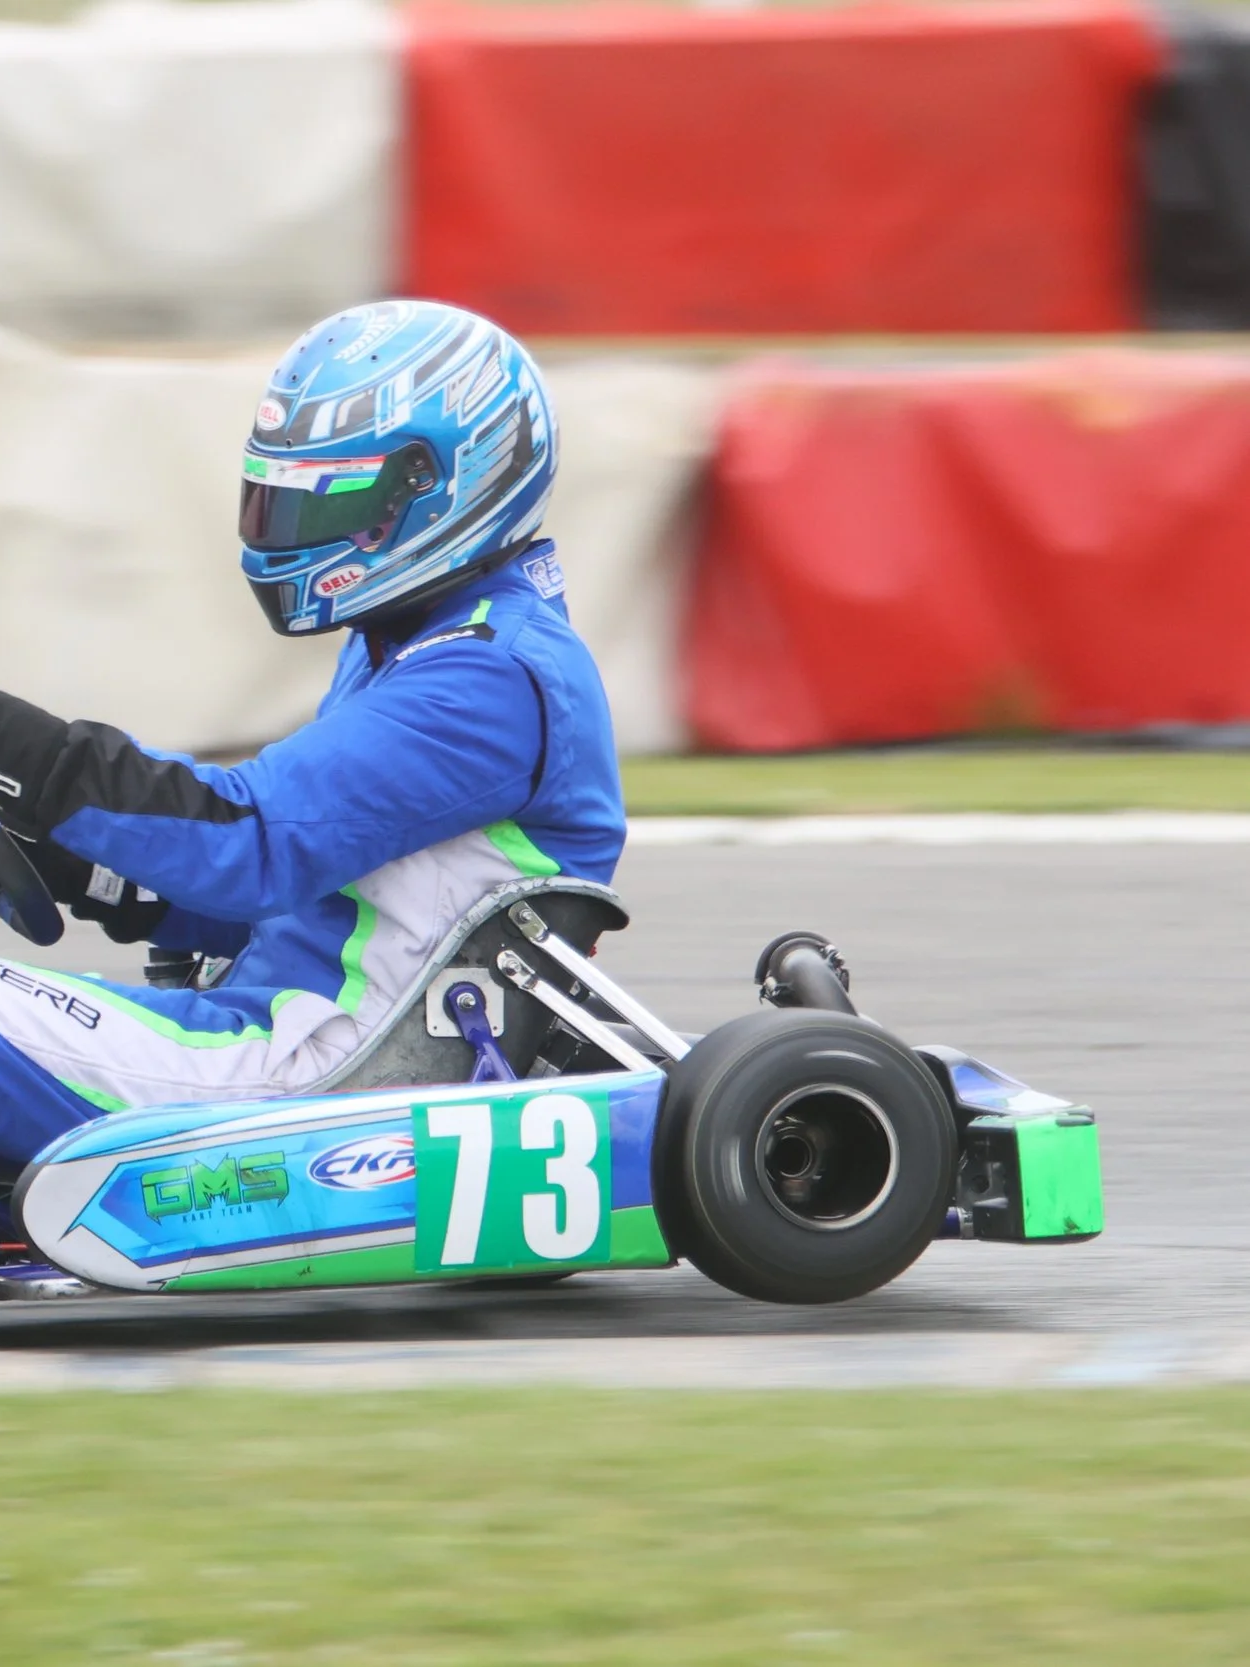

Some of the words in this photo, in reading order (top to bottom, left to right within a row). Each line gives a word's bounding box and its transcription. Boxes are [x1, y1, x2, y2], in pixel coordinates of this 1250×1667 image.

[320, 569, 361, 593] BELL
[140, 1150, 290, 1226] GMS
[426, 1093, 600, 1266] 73
[221, 1204, 253, 1218] TEAM
